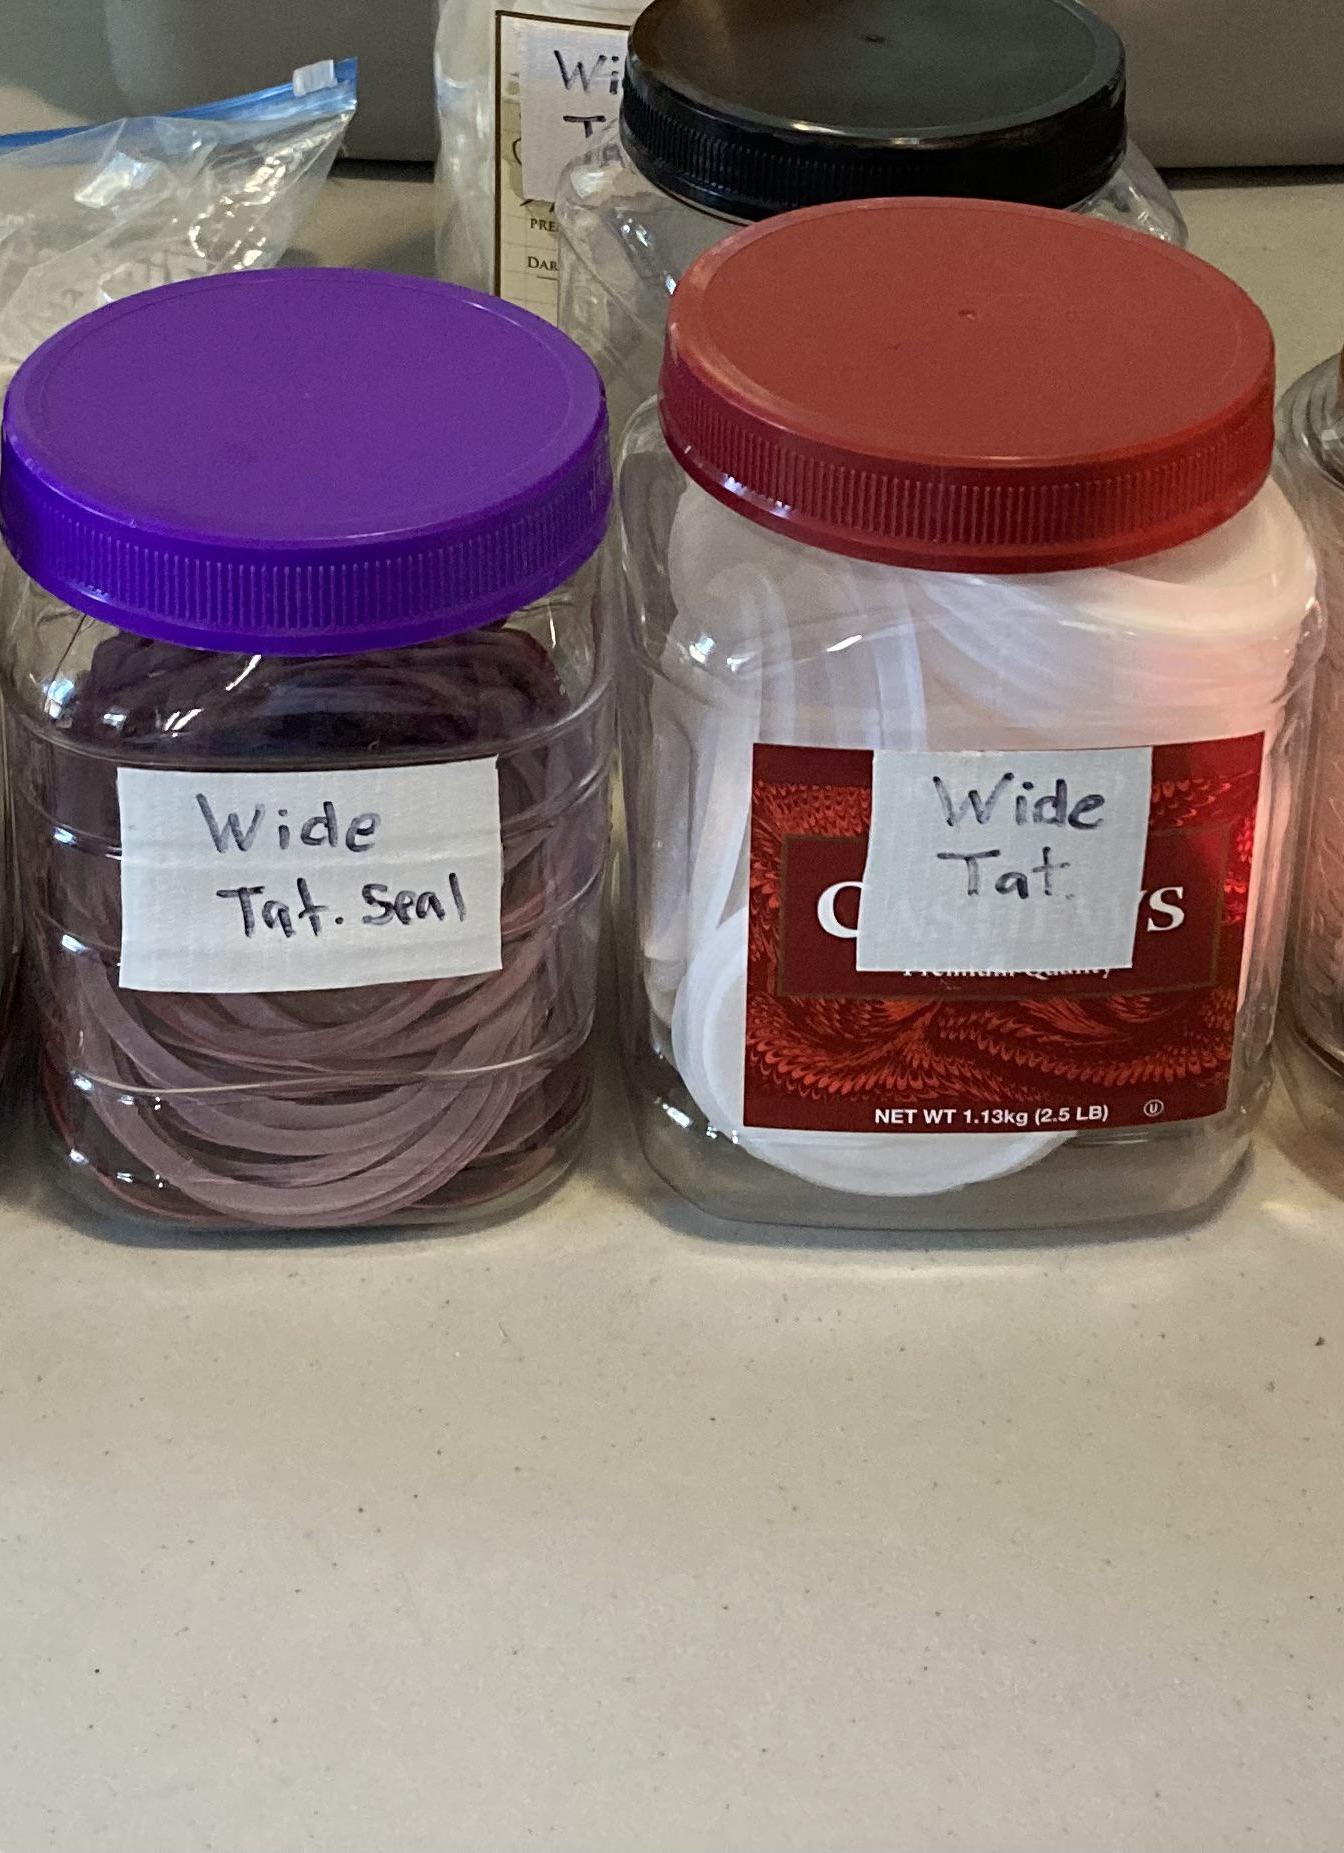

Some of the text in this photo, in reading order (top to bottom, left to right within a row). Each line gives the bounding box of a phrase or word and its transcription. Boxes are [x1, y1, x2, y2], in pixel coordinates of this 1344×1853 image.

[195, 793, 382, 854] Wide
[933, 772, 1107, 830] Wide
[936, 846, 1077, 900] Tat.
[216, 877, 345, 939] Tat.
[874, 1108, 917, 1124] NET
[923, 1108, 956, 1124] WT
[963, 1108, 1028, 1127] 1.13kg
[1035, 1107, 1070, 1126] (2.5
[1076, 1104, 1108, 1122] LB)
